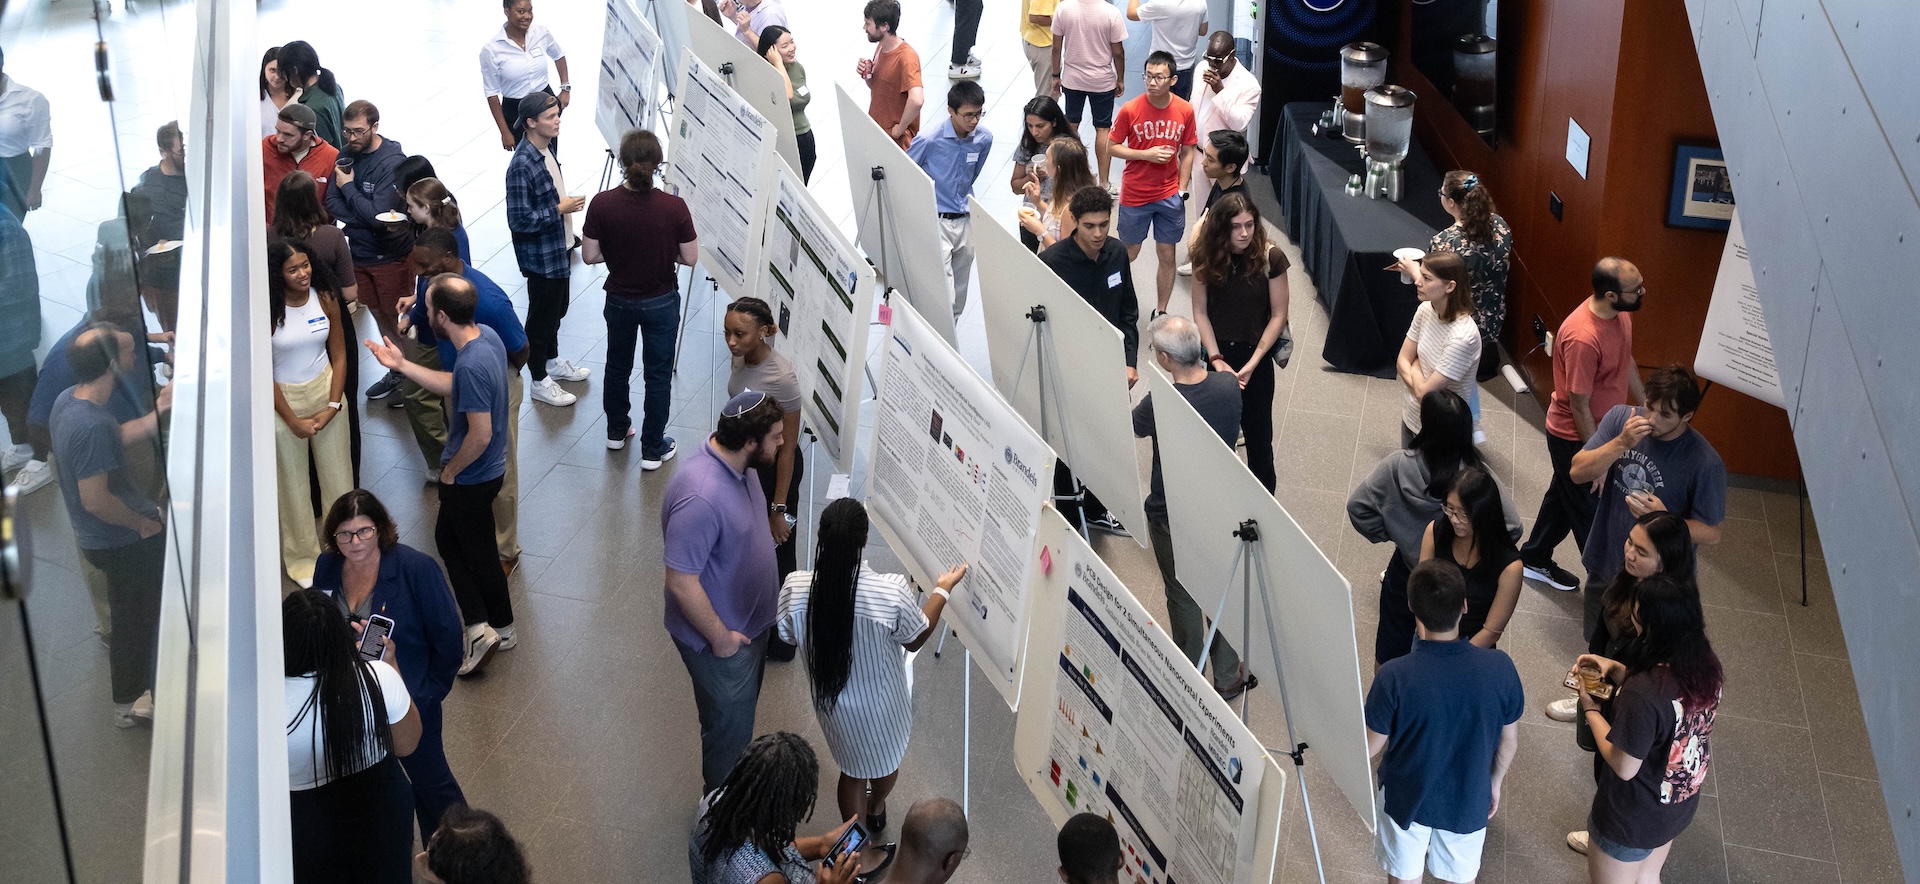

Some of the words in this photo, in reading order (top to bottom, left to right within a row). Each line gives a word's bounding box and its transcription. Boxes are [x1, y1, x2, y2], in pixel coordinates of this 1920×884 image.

[1133, 119, 1185, 143] FOCUS
[955, 387, 967, 403] Artificial
[967, 400, 983, 421] Intelligence
[1013, 454, 1038, 487] Brandeis
[1646, 460, 1665, 489] CREEK
[1082, 571, 1105, 605] Brandeis
[1083, 605, 1106, 637] Introduction
[1086, 564, 1095, 581] PCB
[1096, 577, 1113, 603] Design
[1123, 607, 1126, 617] 2
[1127, 611, 1163, 661] Simultaneous
[1165, 656, 1197, 703] Nanocrystal
[1198, 697, 1235, 749] Experiments
[1156, 693, 1177, 726] Challenges
[1210, 726, 1228, 754] Brandeis
[1186, 731, 1196, 750] Final
[1196, 745, 1211, 770] Design
[1219, 774, 1228, 793] Next
[1229, 787, 1240, 810] Steps
[1209, 746, 1226, 770] MRSEC
